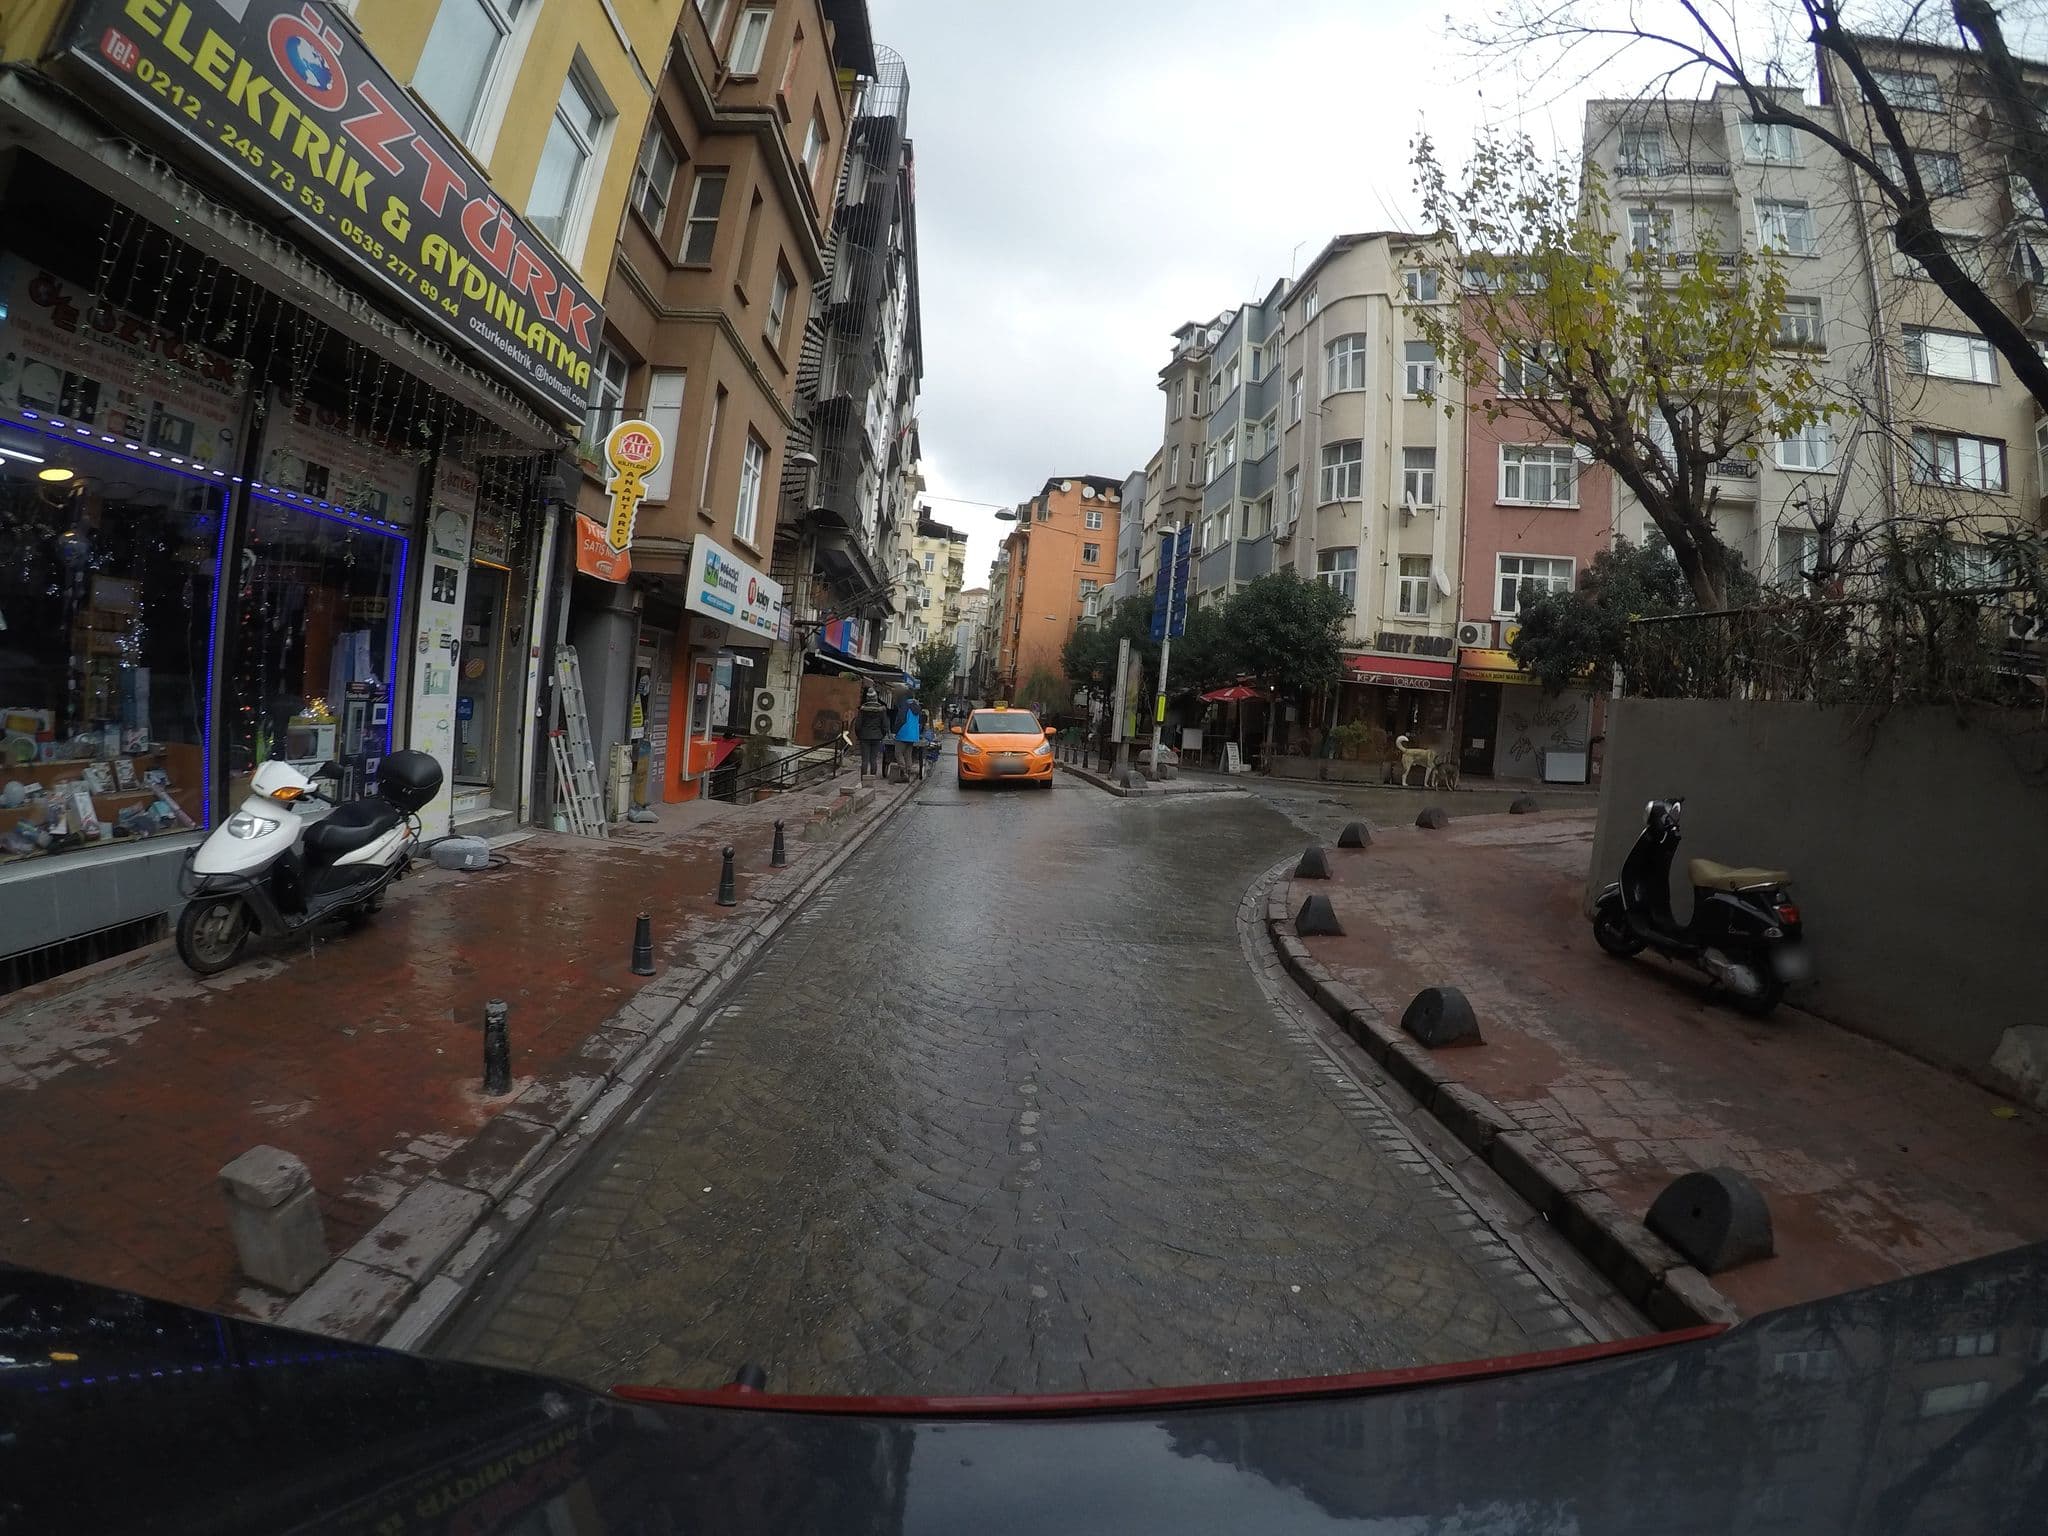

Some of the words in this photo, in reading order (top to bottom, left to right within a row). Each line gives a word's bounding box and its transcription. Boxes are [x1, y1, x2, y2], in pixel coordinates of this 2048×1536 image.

[106, 28, 135, 70] Tel:
[136, 58, 202, 121] 0212
[219, 124, 265, 168] 245
[268, 160, 296, 192] 73
[299, 185, 326, 215] 53
[340, 218, 385, 260] 0535
[386, 254, 418, 284] 277
[419, 279, 439, 301] 89
[440, 297, 460, 318] 44
[124, 0, 375, 214] ELEKTRİK
[381, 195, 412, 244] &
[420, 233, 591, 390] AYDINLATMA
[267, 4, 596, 354] ÖZTÜRK
[616, 471, 635, 544] ANAHTARCI
[617, 435, 654, 463] KALE
[1357, 674, 1382, 684] KEYF
[1392, 676, 1431, 689] TOBACCO
